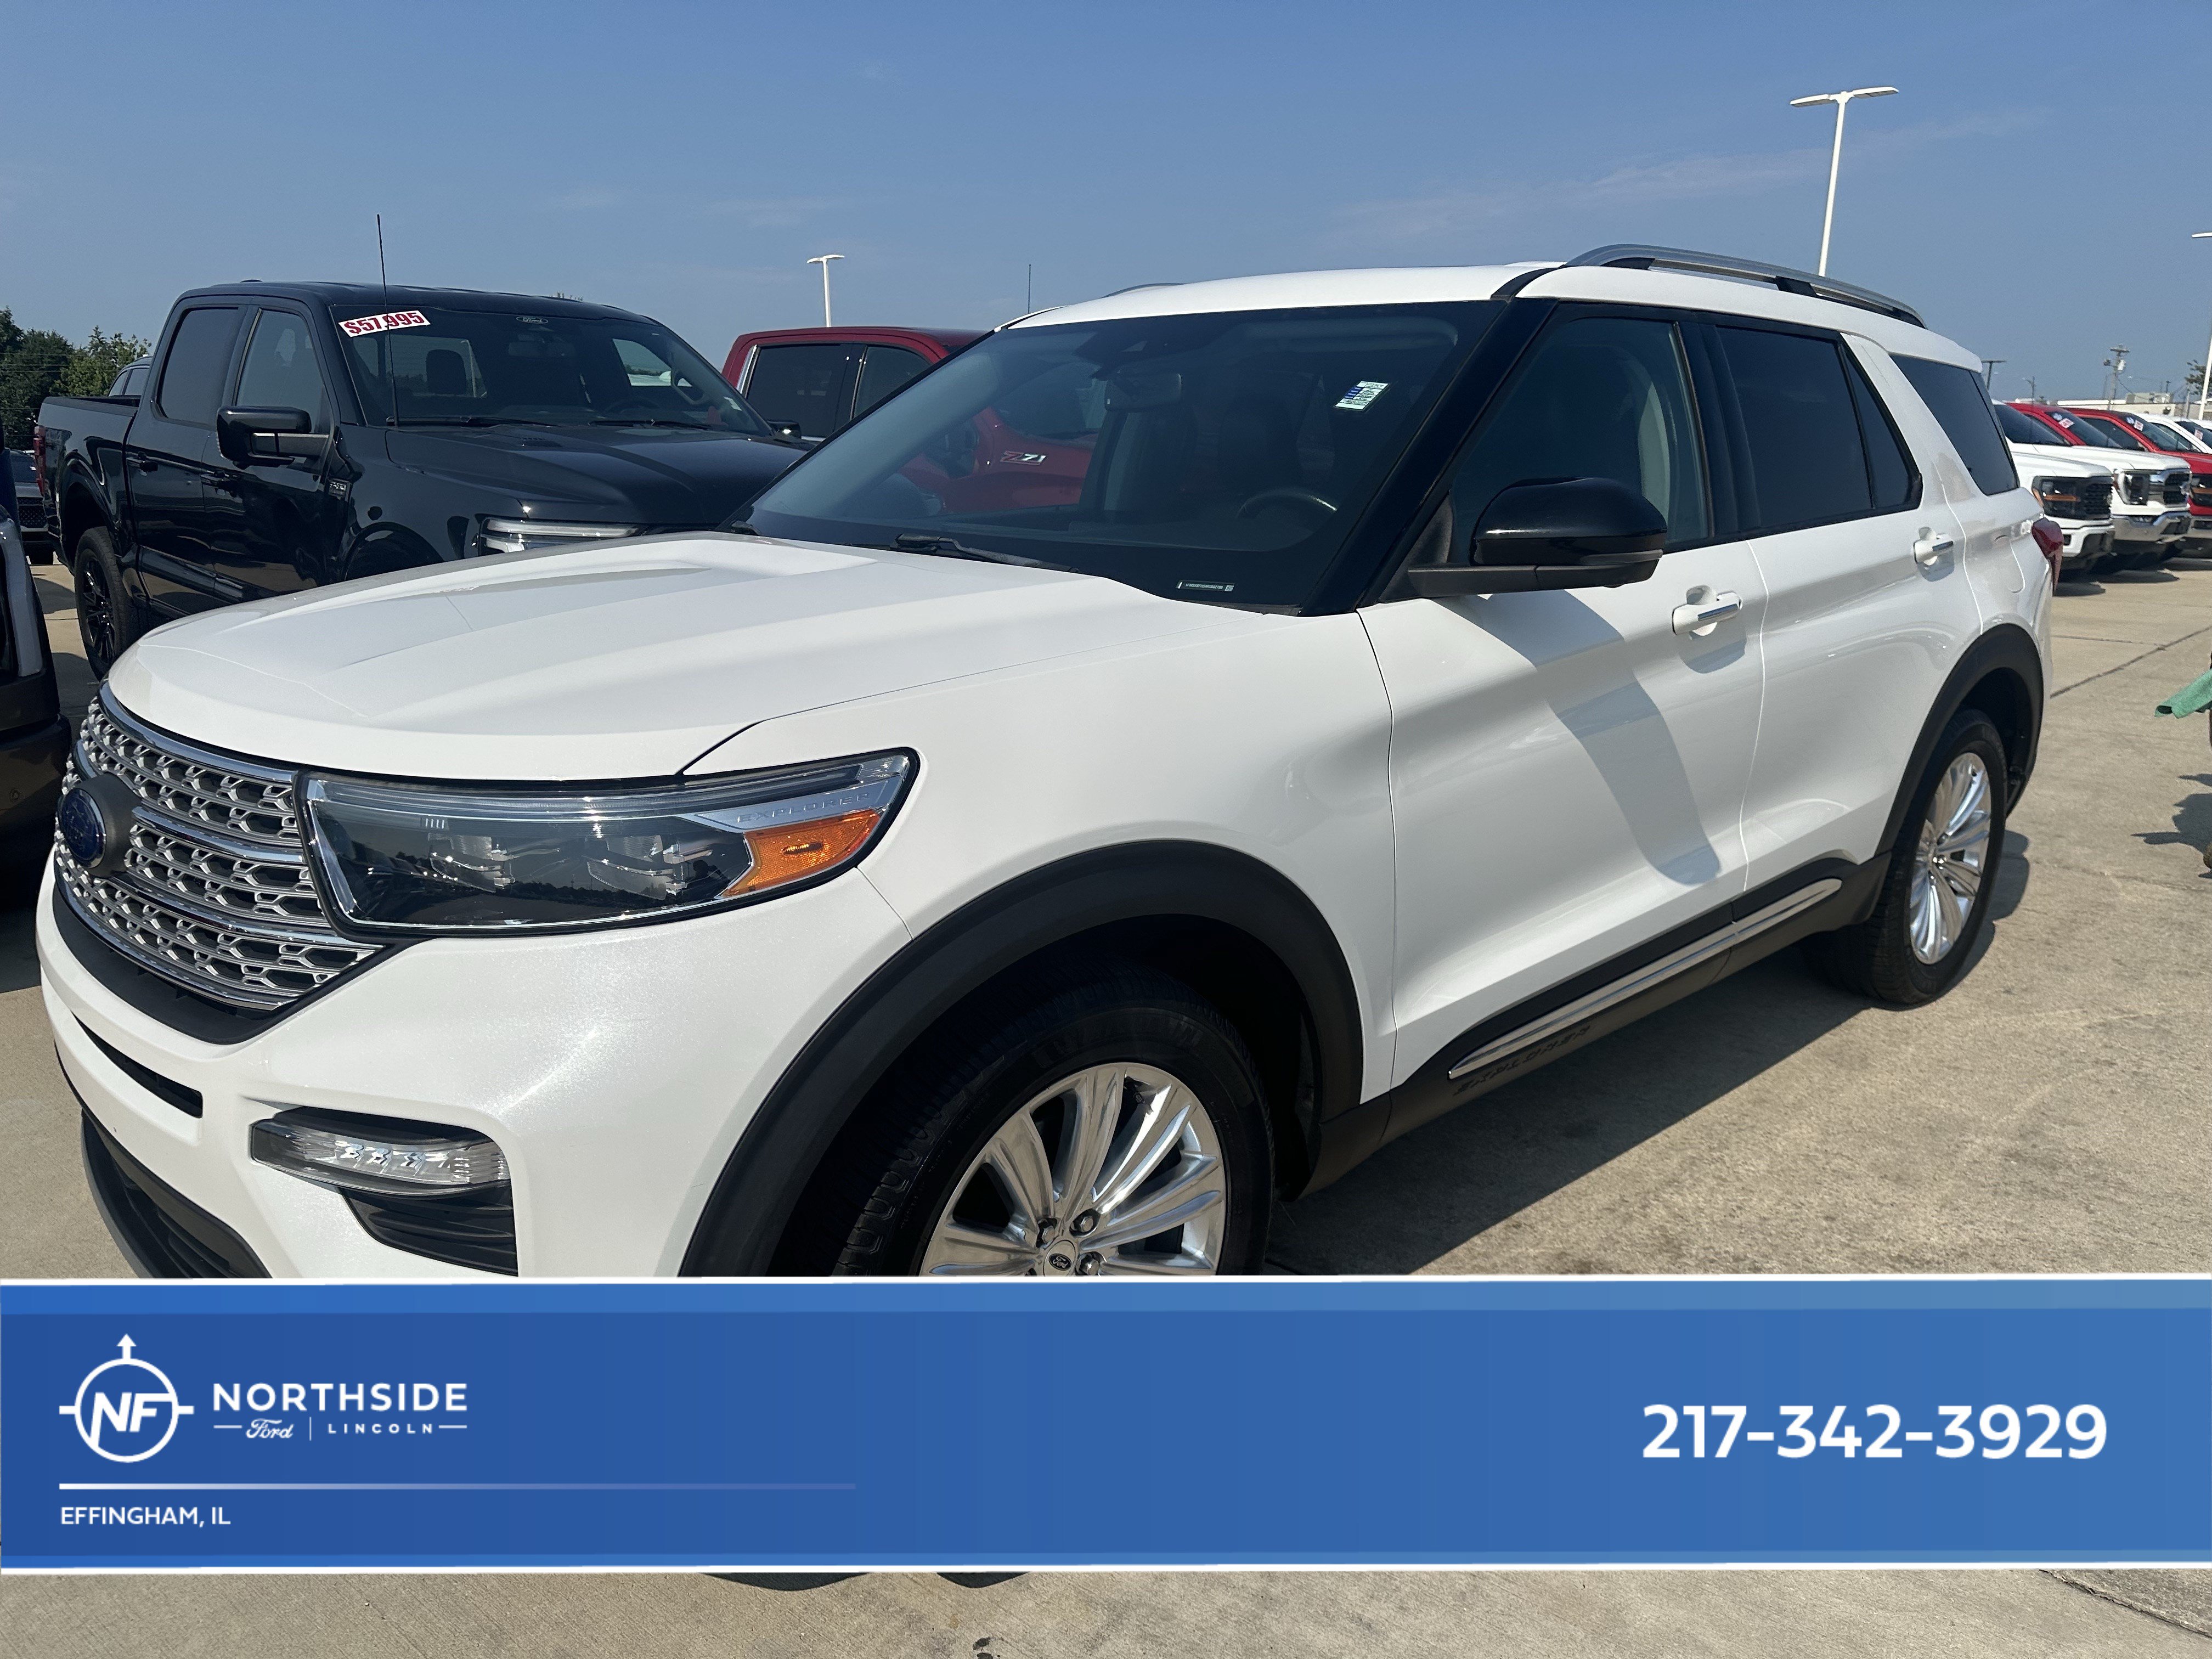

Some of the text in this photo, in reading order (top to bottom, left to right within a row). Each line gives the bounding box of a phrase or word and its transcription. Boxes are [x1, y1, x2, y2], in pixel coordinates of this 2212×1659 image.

[1000, 450, 1046, 465] Z71
[737, 793, 870, 823] EXPLORER
[1052, 1256, 1069, 1268] Ford
